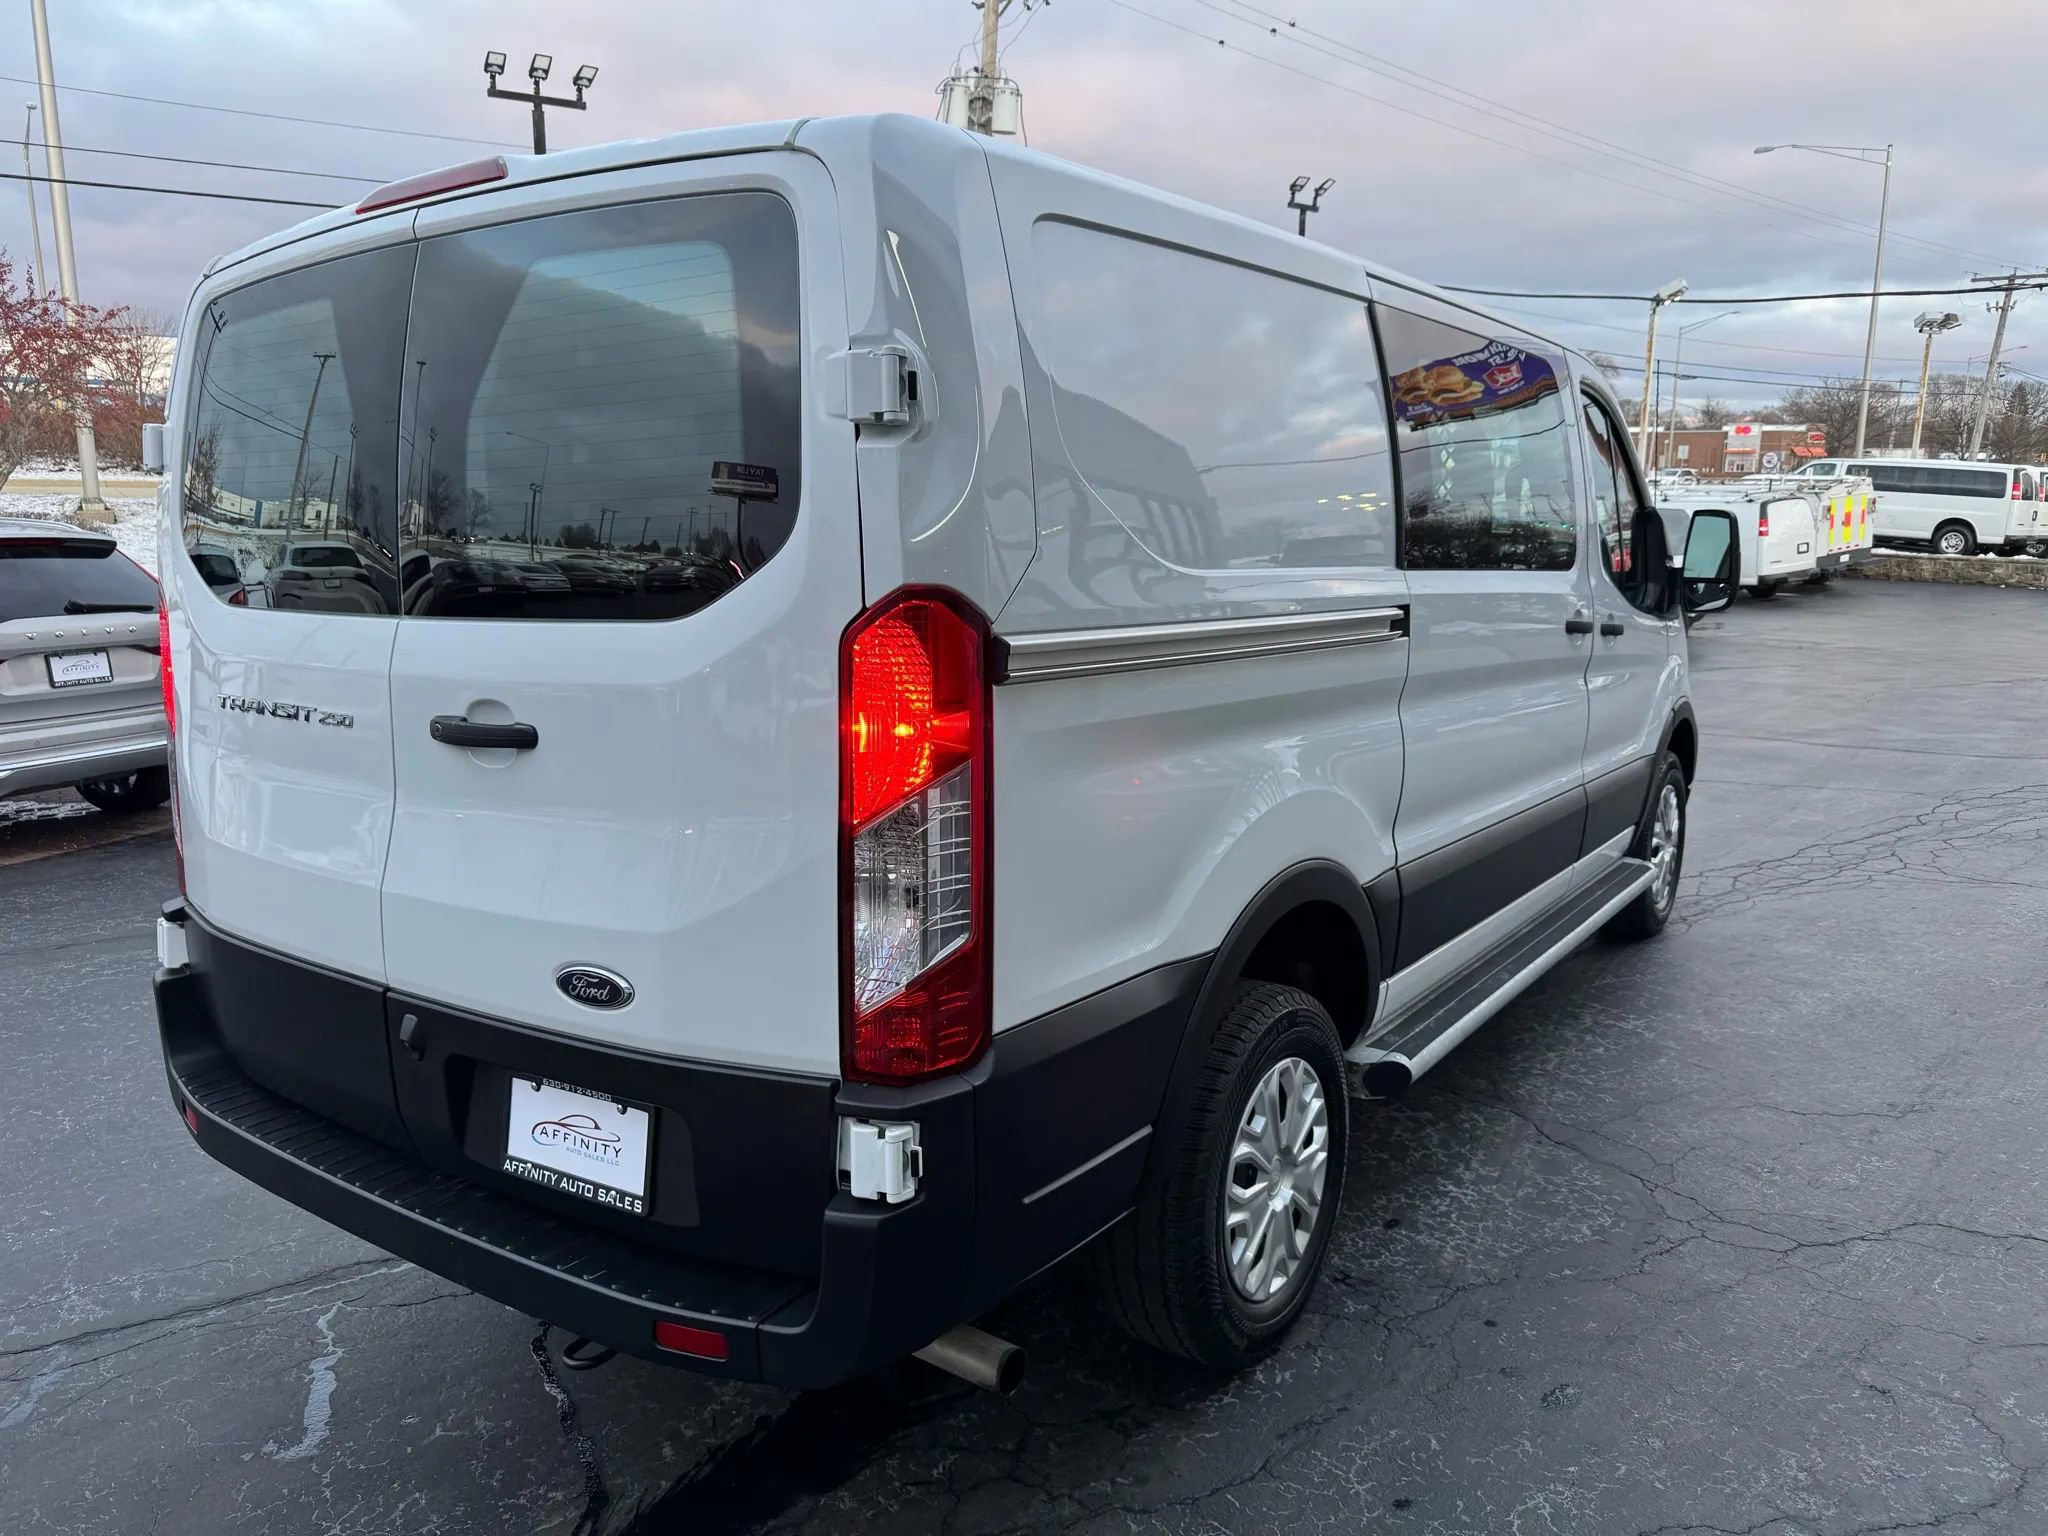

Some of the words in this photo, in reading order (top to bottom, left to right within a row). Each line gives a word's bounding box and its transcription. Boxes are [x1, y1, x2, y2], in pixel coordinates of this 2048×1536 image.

[25, 626, 137, 640] VOLVO
[216, 693, 318, 722] TRANSIT
[319, 711, 353, 728] 250
[569, 974, 611, 1001] Ford
[540, 1126, 622, 1158] AFFINITY
[566, 1147, 582, 1156] AUTO
[584, 1152, 605, 1163] SALES
[607, 1158, 620, 1166] LLC
[503, 1159, 558, 1185] AFFINITY
[560, 1177, 594, 1197] AUTO
[598, 1188, 642, 1213] SALES
